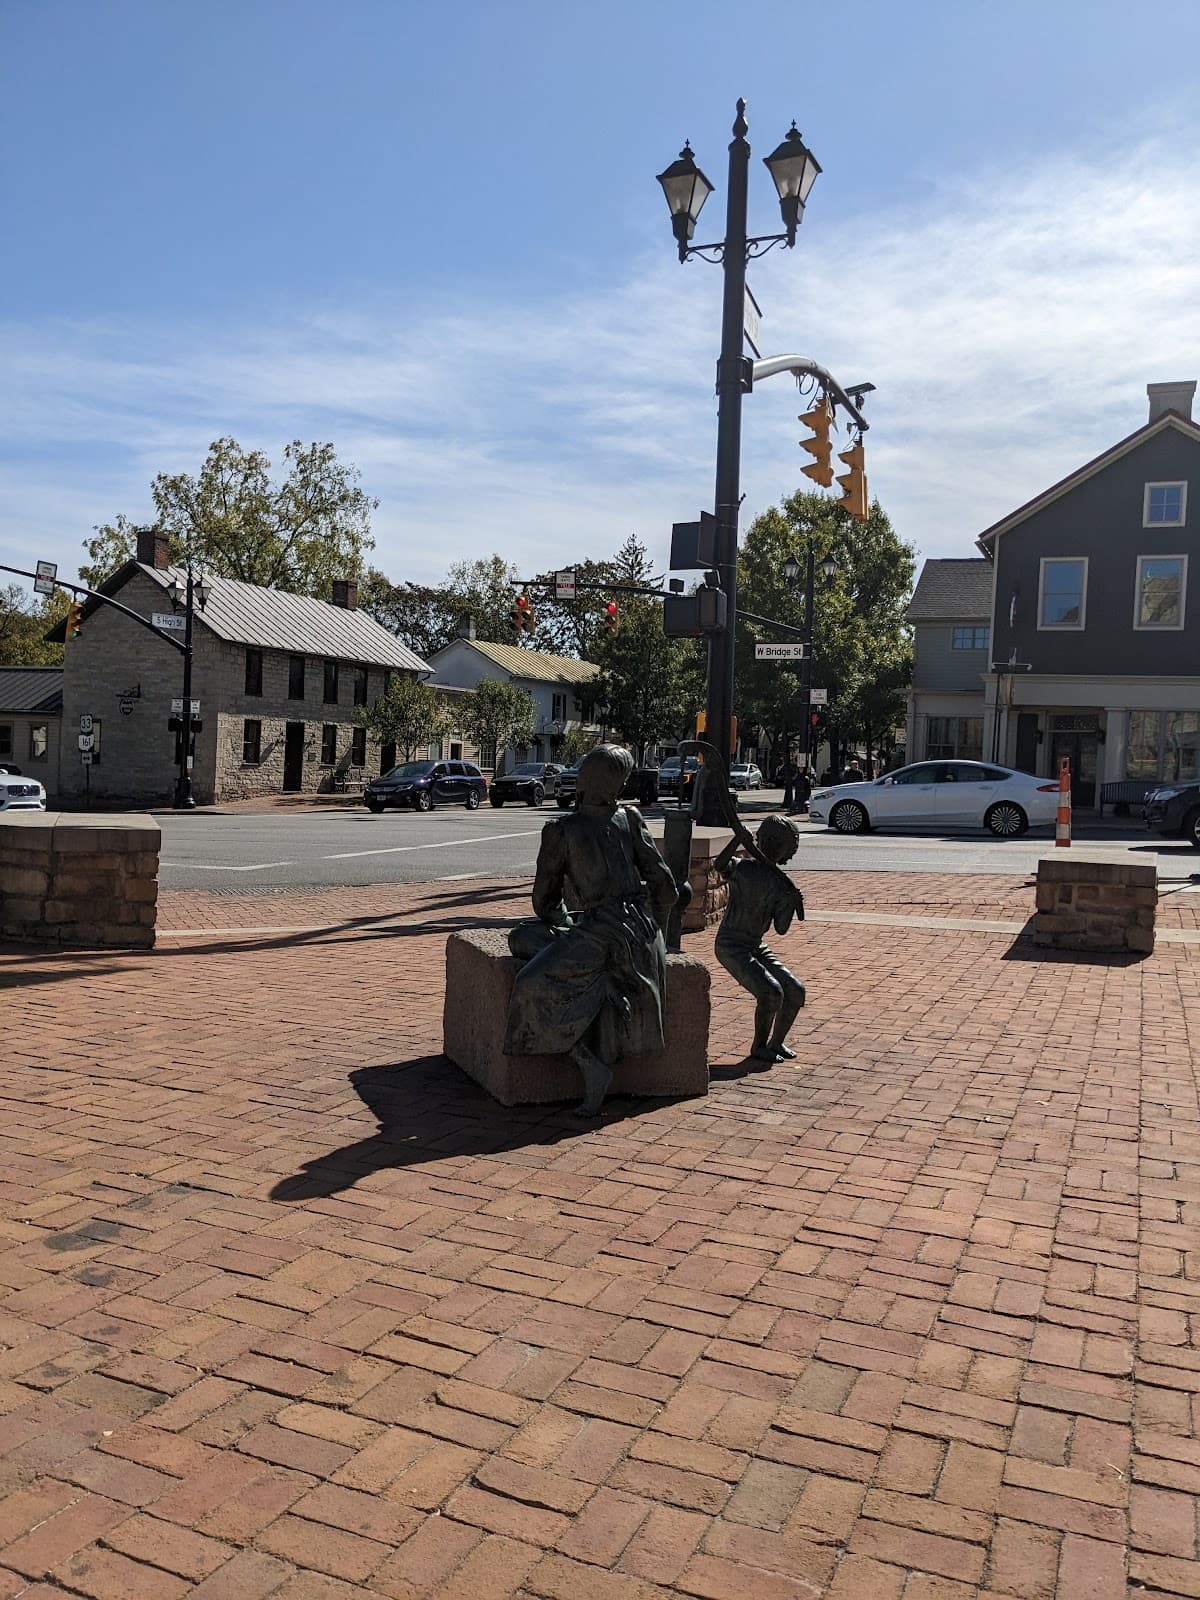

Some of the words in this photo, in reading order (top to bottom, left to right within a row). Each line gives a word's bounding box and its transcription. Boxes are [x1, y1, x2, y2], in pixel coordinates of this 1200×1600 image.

[156, 616, 161, 624] S
[162, 615, 175, 626] High
[757, 647, 764, 656] W
[766, 647, 791, 658] Bridge
[793, 647, 801, 656] St
[81, 718, 91, 729] 33
[82, 737, 91, 747] 161
